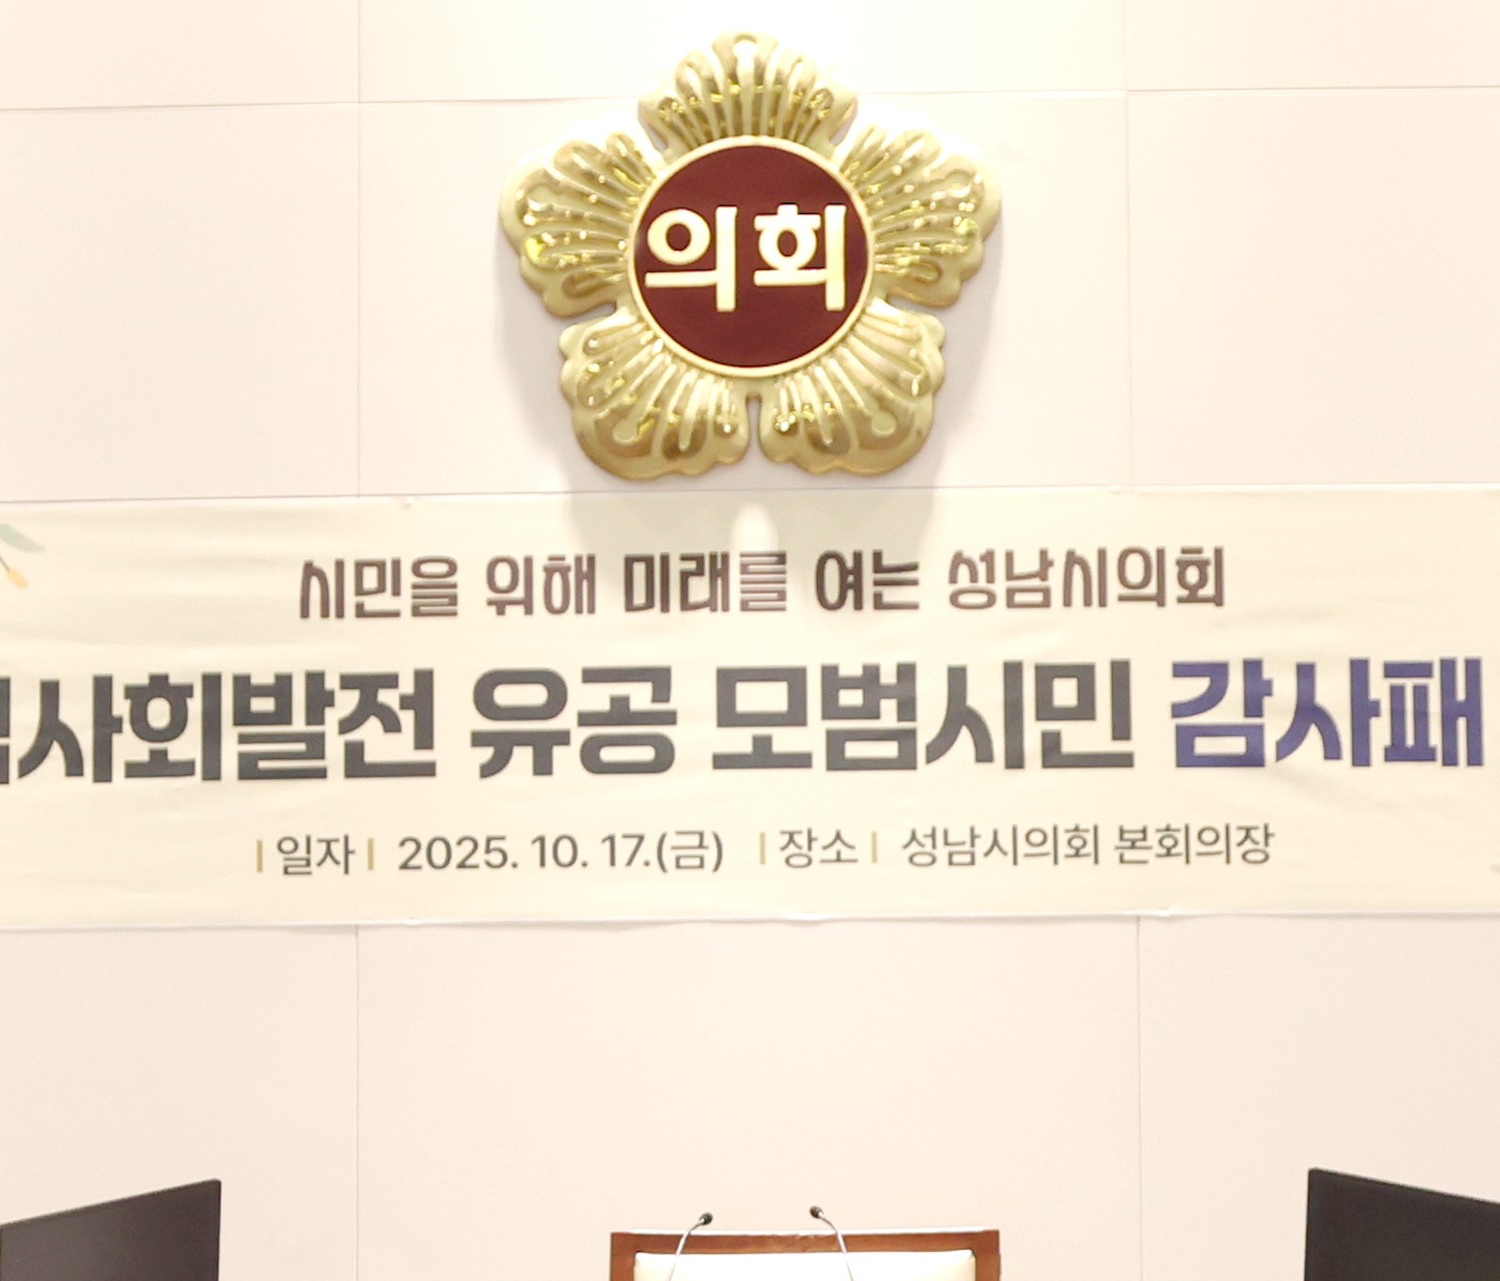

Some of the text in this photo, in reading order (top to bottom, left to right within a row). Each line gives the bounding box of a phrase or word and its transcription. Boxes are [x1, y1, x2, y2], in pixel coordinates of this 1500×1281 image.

[645, 204, 847, 311] 의회
[299, 546, 1225, 620] 시민을 위해 미래를 여는 성남시의회
[470, 666, 678, 780] 유공
[711, 659, 1135, 772] 모범시민
[1170, 657, 1484, 769] 감사패
[276, 822, 1275, 876] 일자 2025. 10. 17.(금) 장소 성남시의회 본회의장
